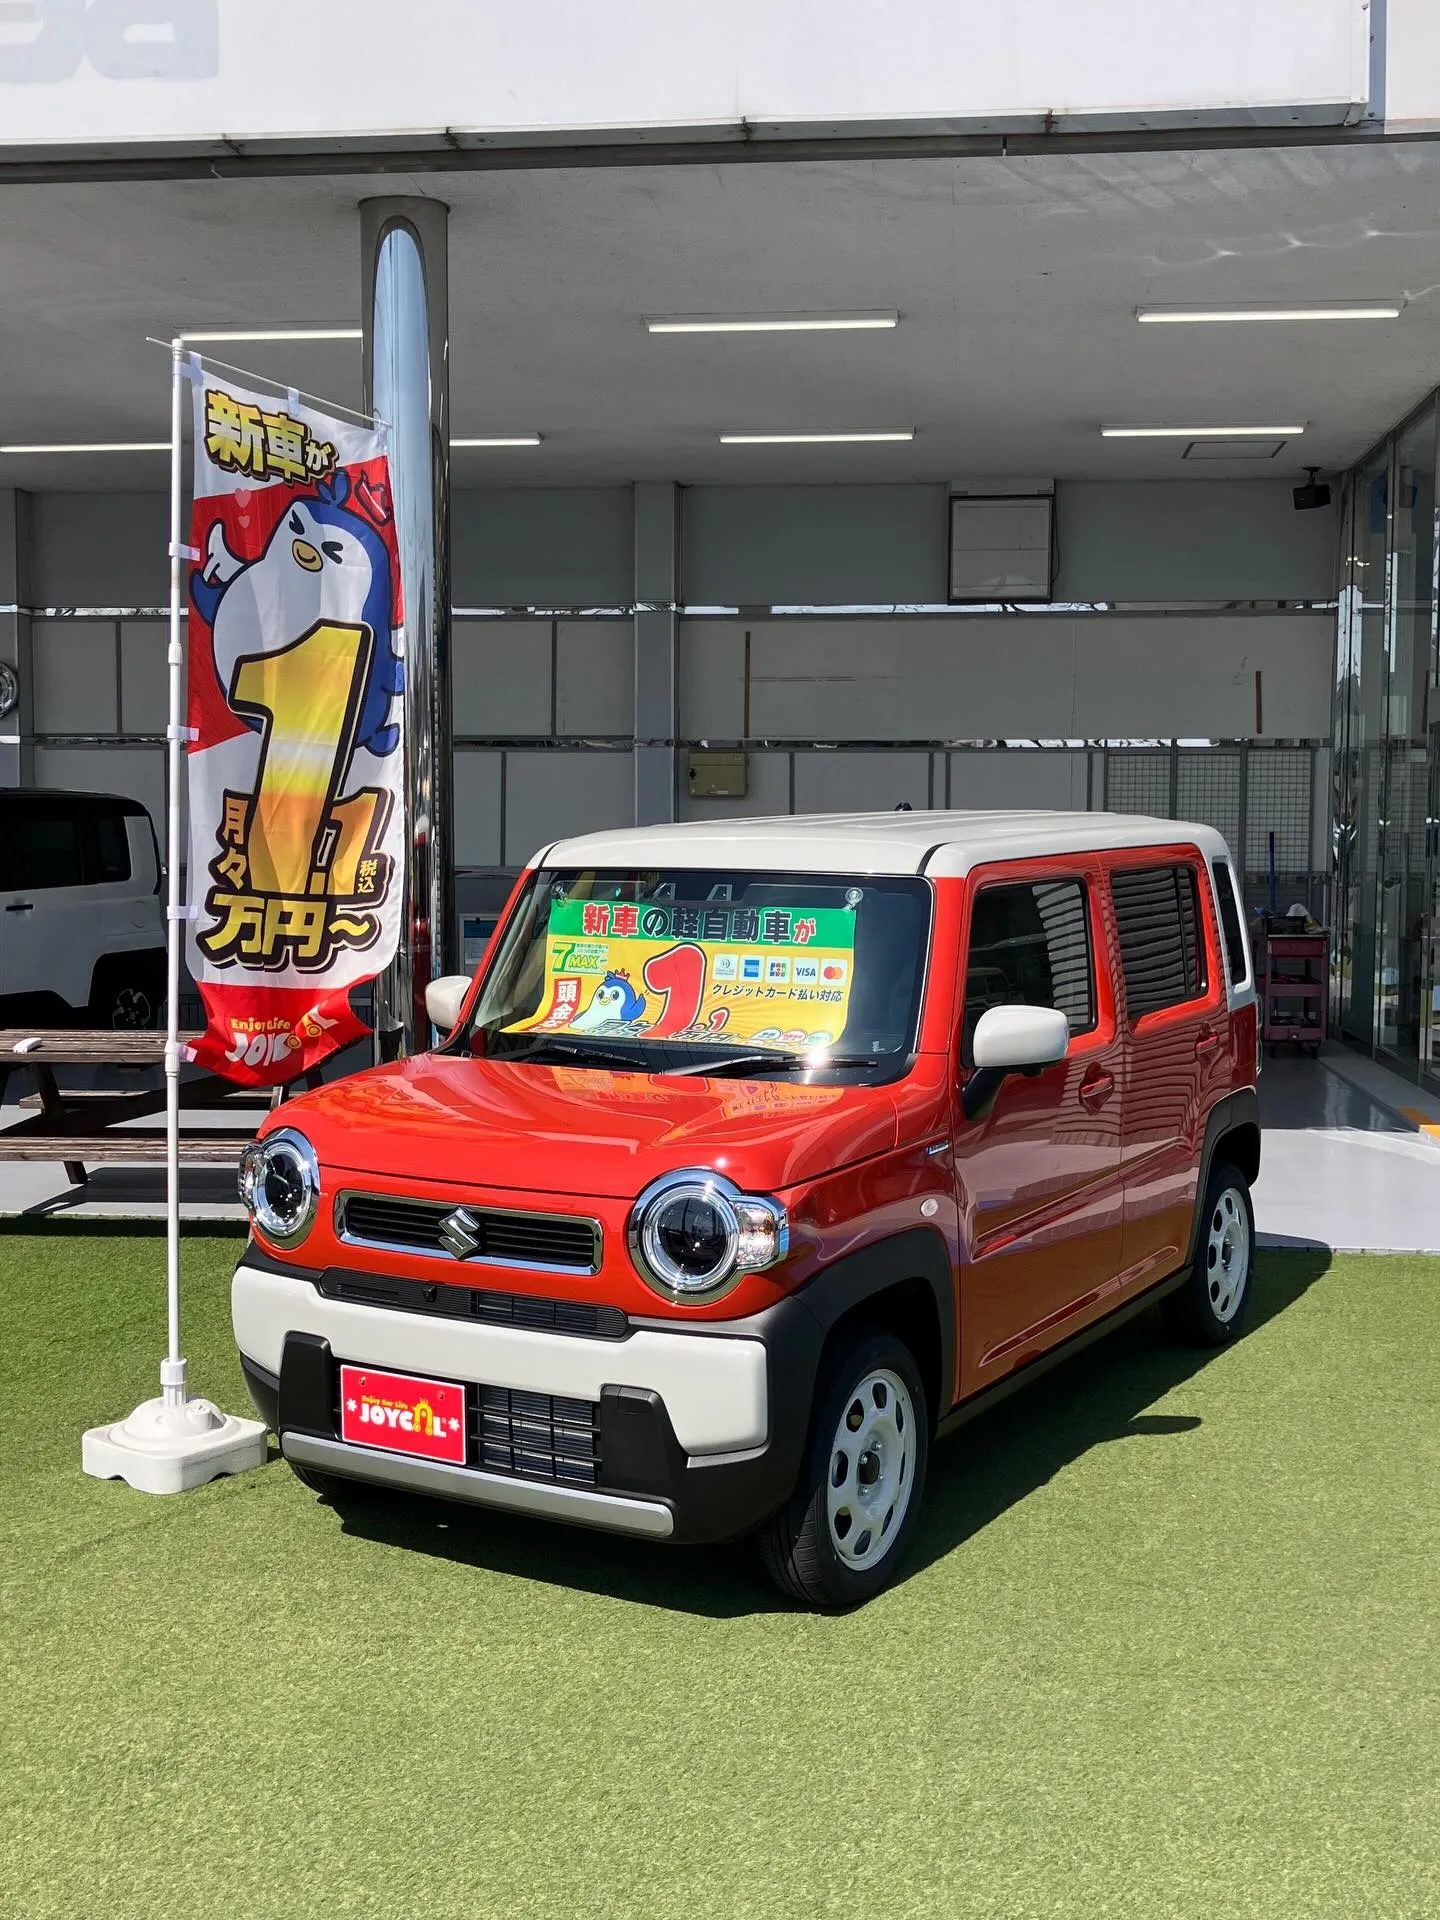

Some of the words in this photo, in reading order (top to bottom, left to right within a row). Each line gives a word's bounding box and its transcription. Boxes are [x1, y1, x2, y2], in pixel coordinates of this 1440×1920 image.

[205, 389, 338, 482] 新車が
[216, 797, 249, 890] 月々
[358, 858, 377, 894] 税込
[583, 903, 817, 943] 新車の軽自動車が
[795, 966, 816, 977] VISA
[712, 984, 843, 1002] クレジットカード払い対応
[360, 1399, 447, 1438] JOYCAL
